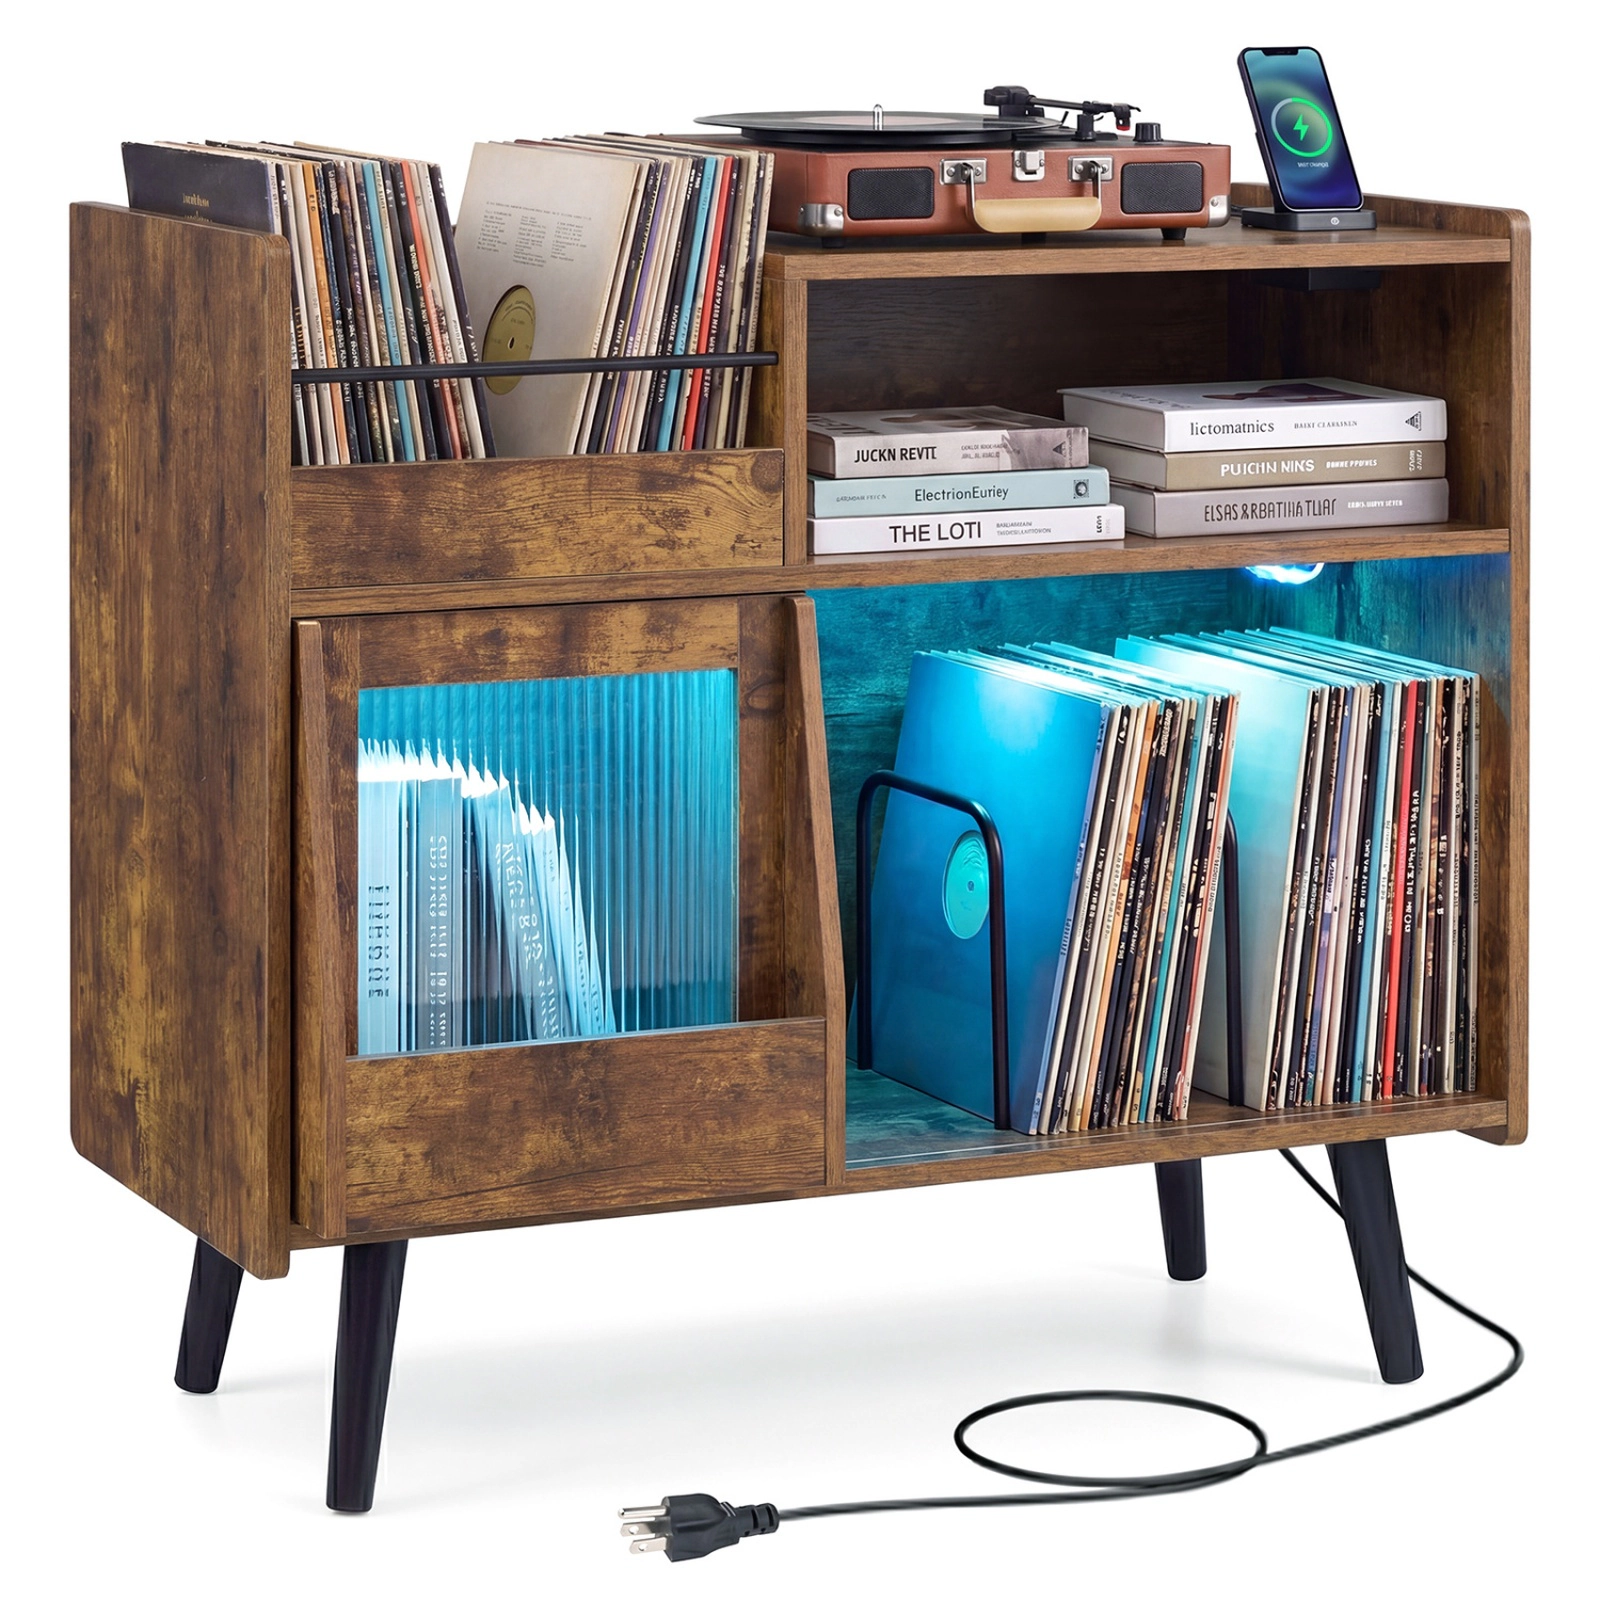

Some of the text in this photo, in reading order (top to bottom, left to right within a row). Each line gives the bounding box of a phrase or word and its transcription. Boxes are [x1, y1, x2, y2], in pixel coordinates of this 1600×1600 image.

[1190, 419, 1275, 436] lictomatnics
[854, 447, 896, 463] JUCKN
[914, 485, 1009, 502] ElectrionEuriey
[889, 521, 981, 543] THE LOTI
